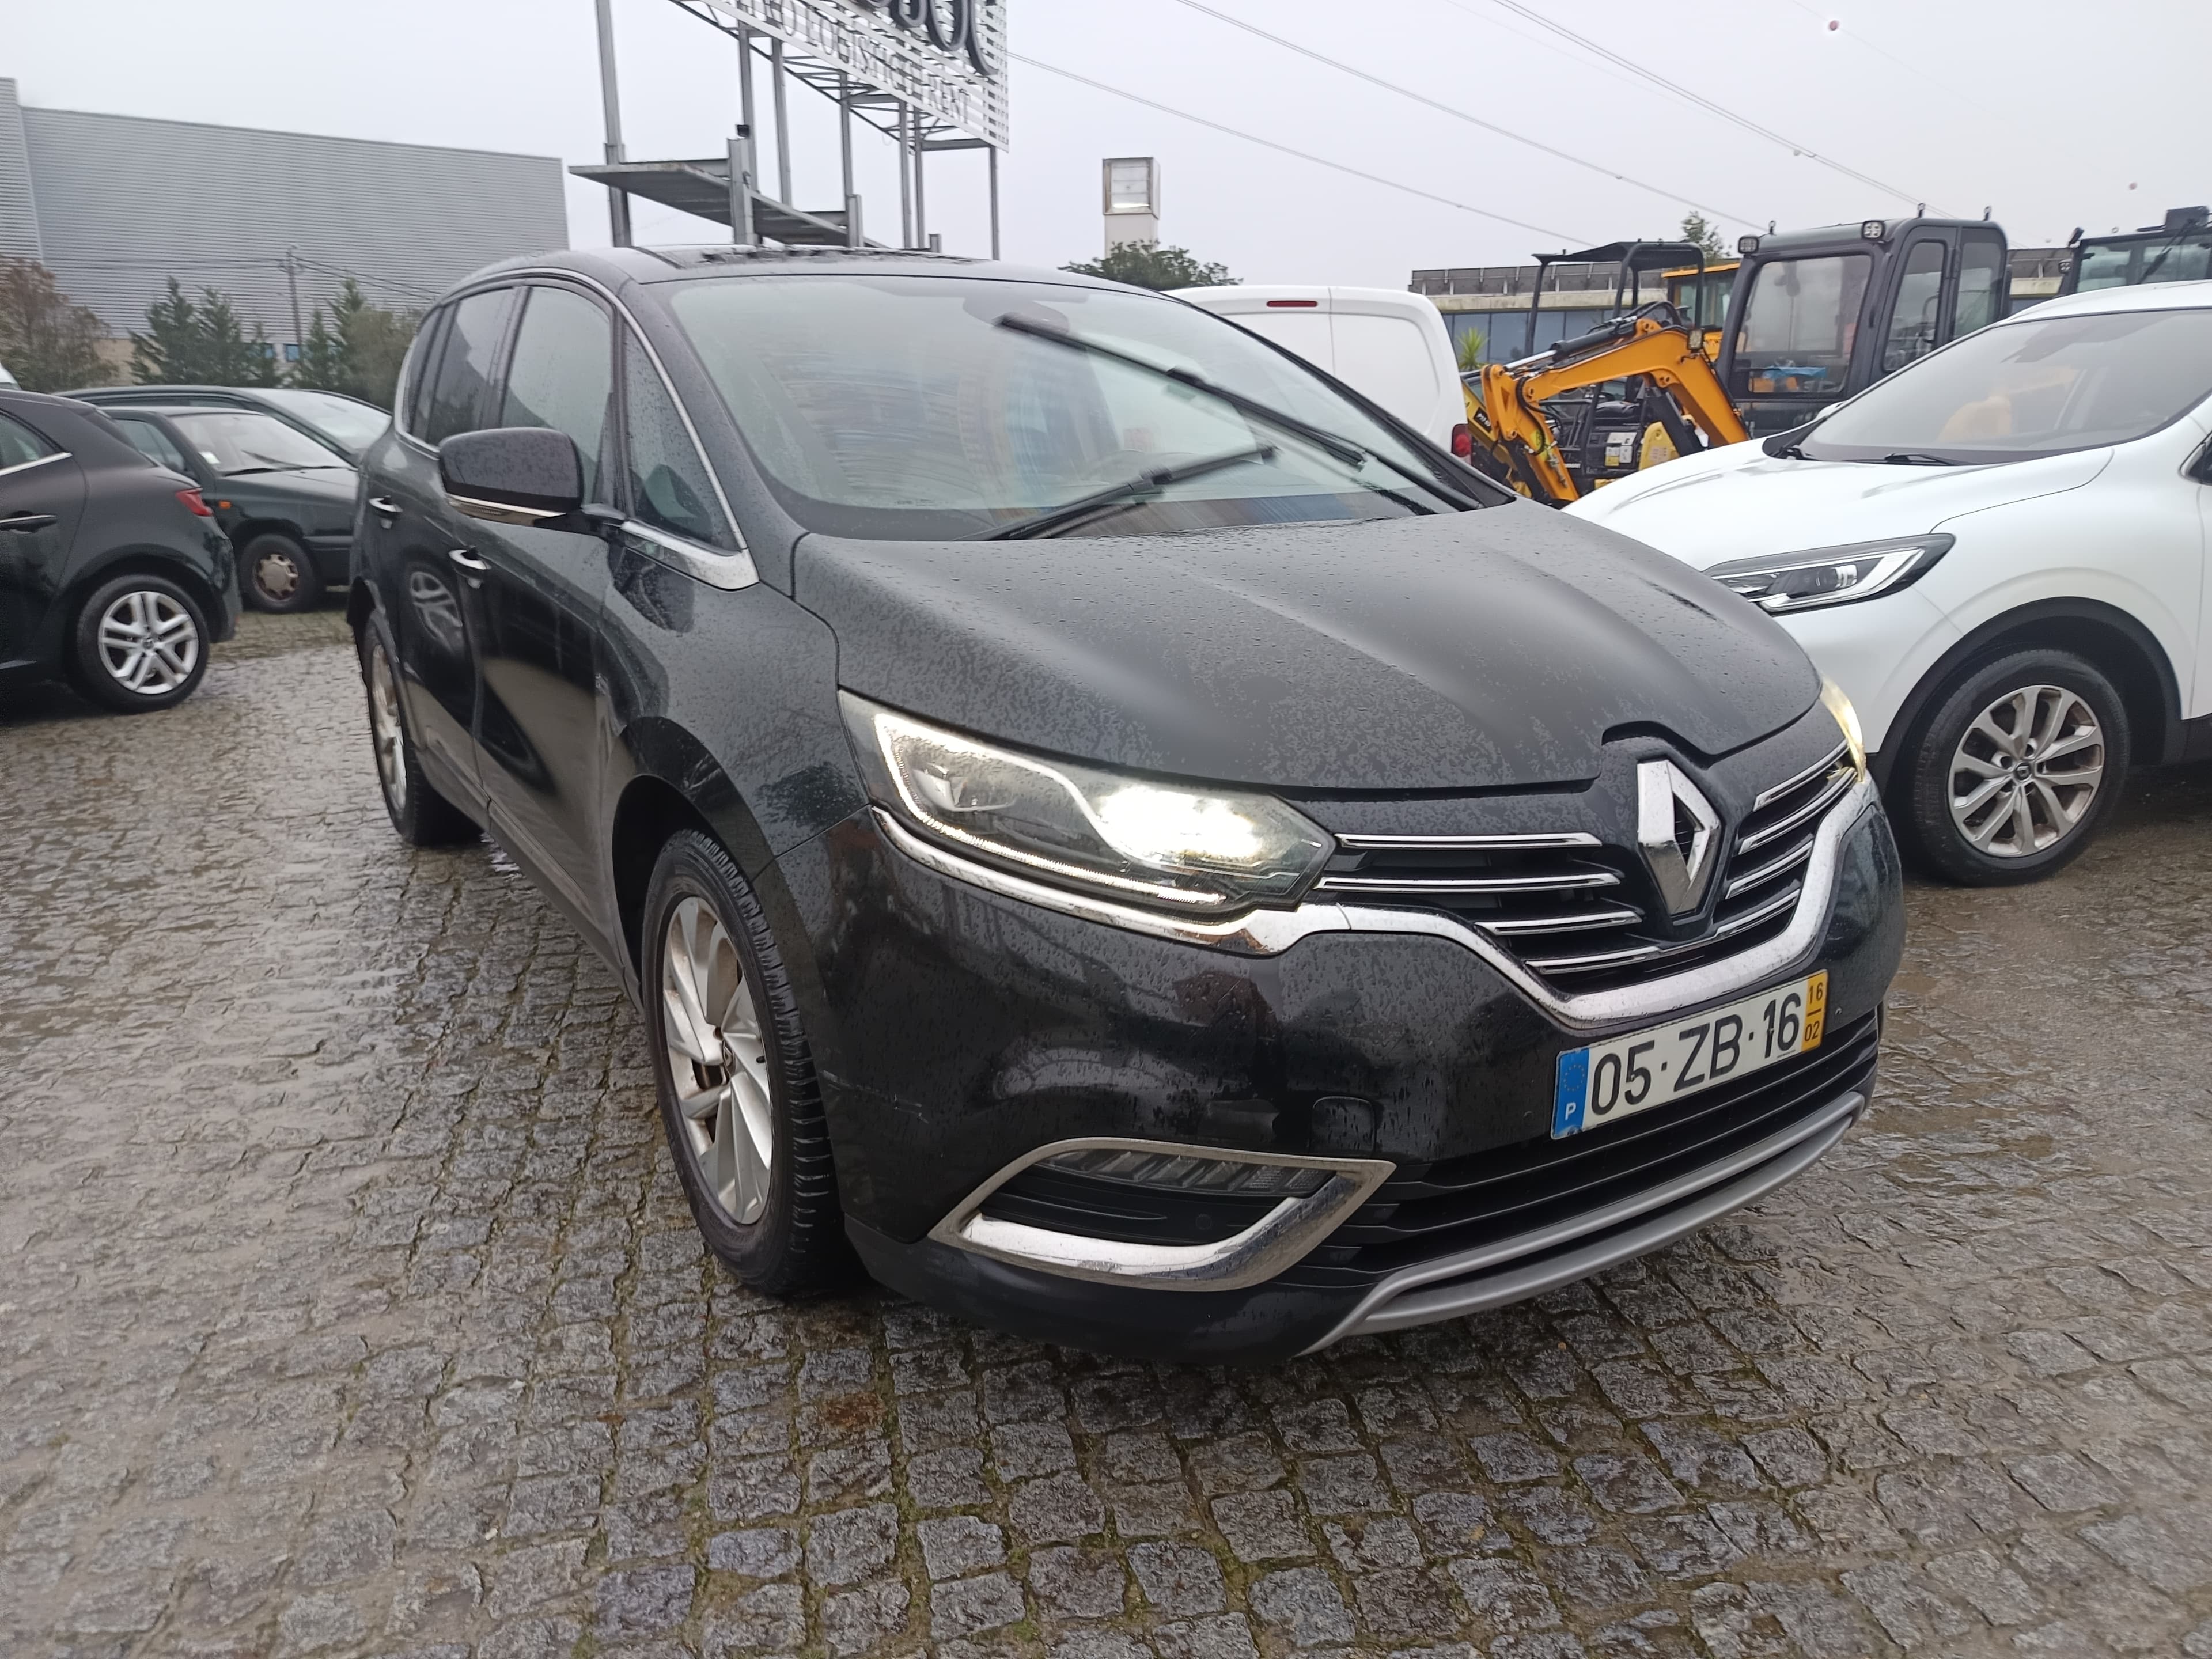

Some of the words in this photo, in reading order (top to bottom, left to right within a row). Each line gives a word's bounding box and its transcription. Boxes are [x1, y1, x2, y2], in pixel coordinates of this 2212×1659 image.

[1808, 981, 1824, 1003] 16
[1804, 1021, 1820, 1042] 02
[1565, 1101, 1576, 1120] P
